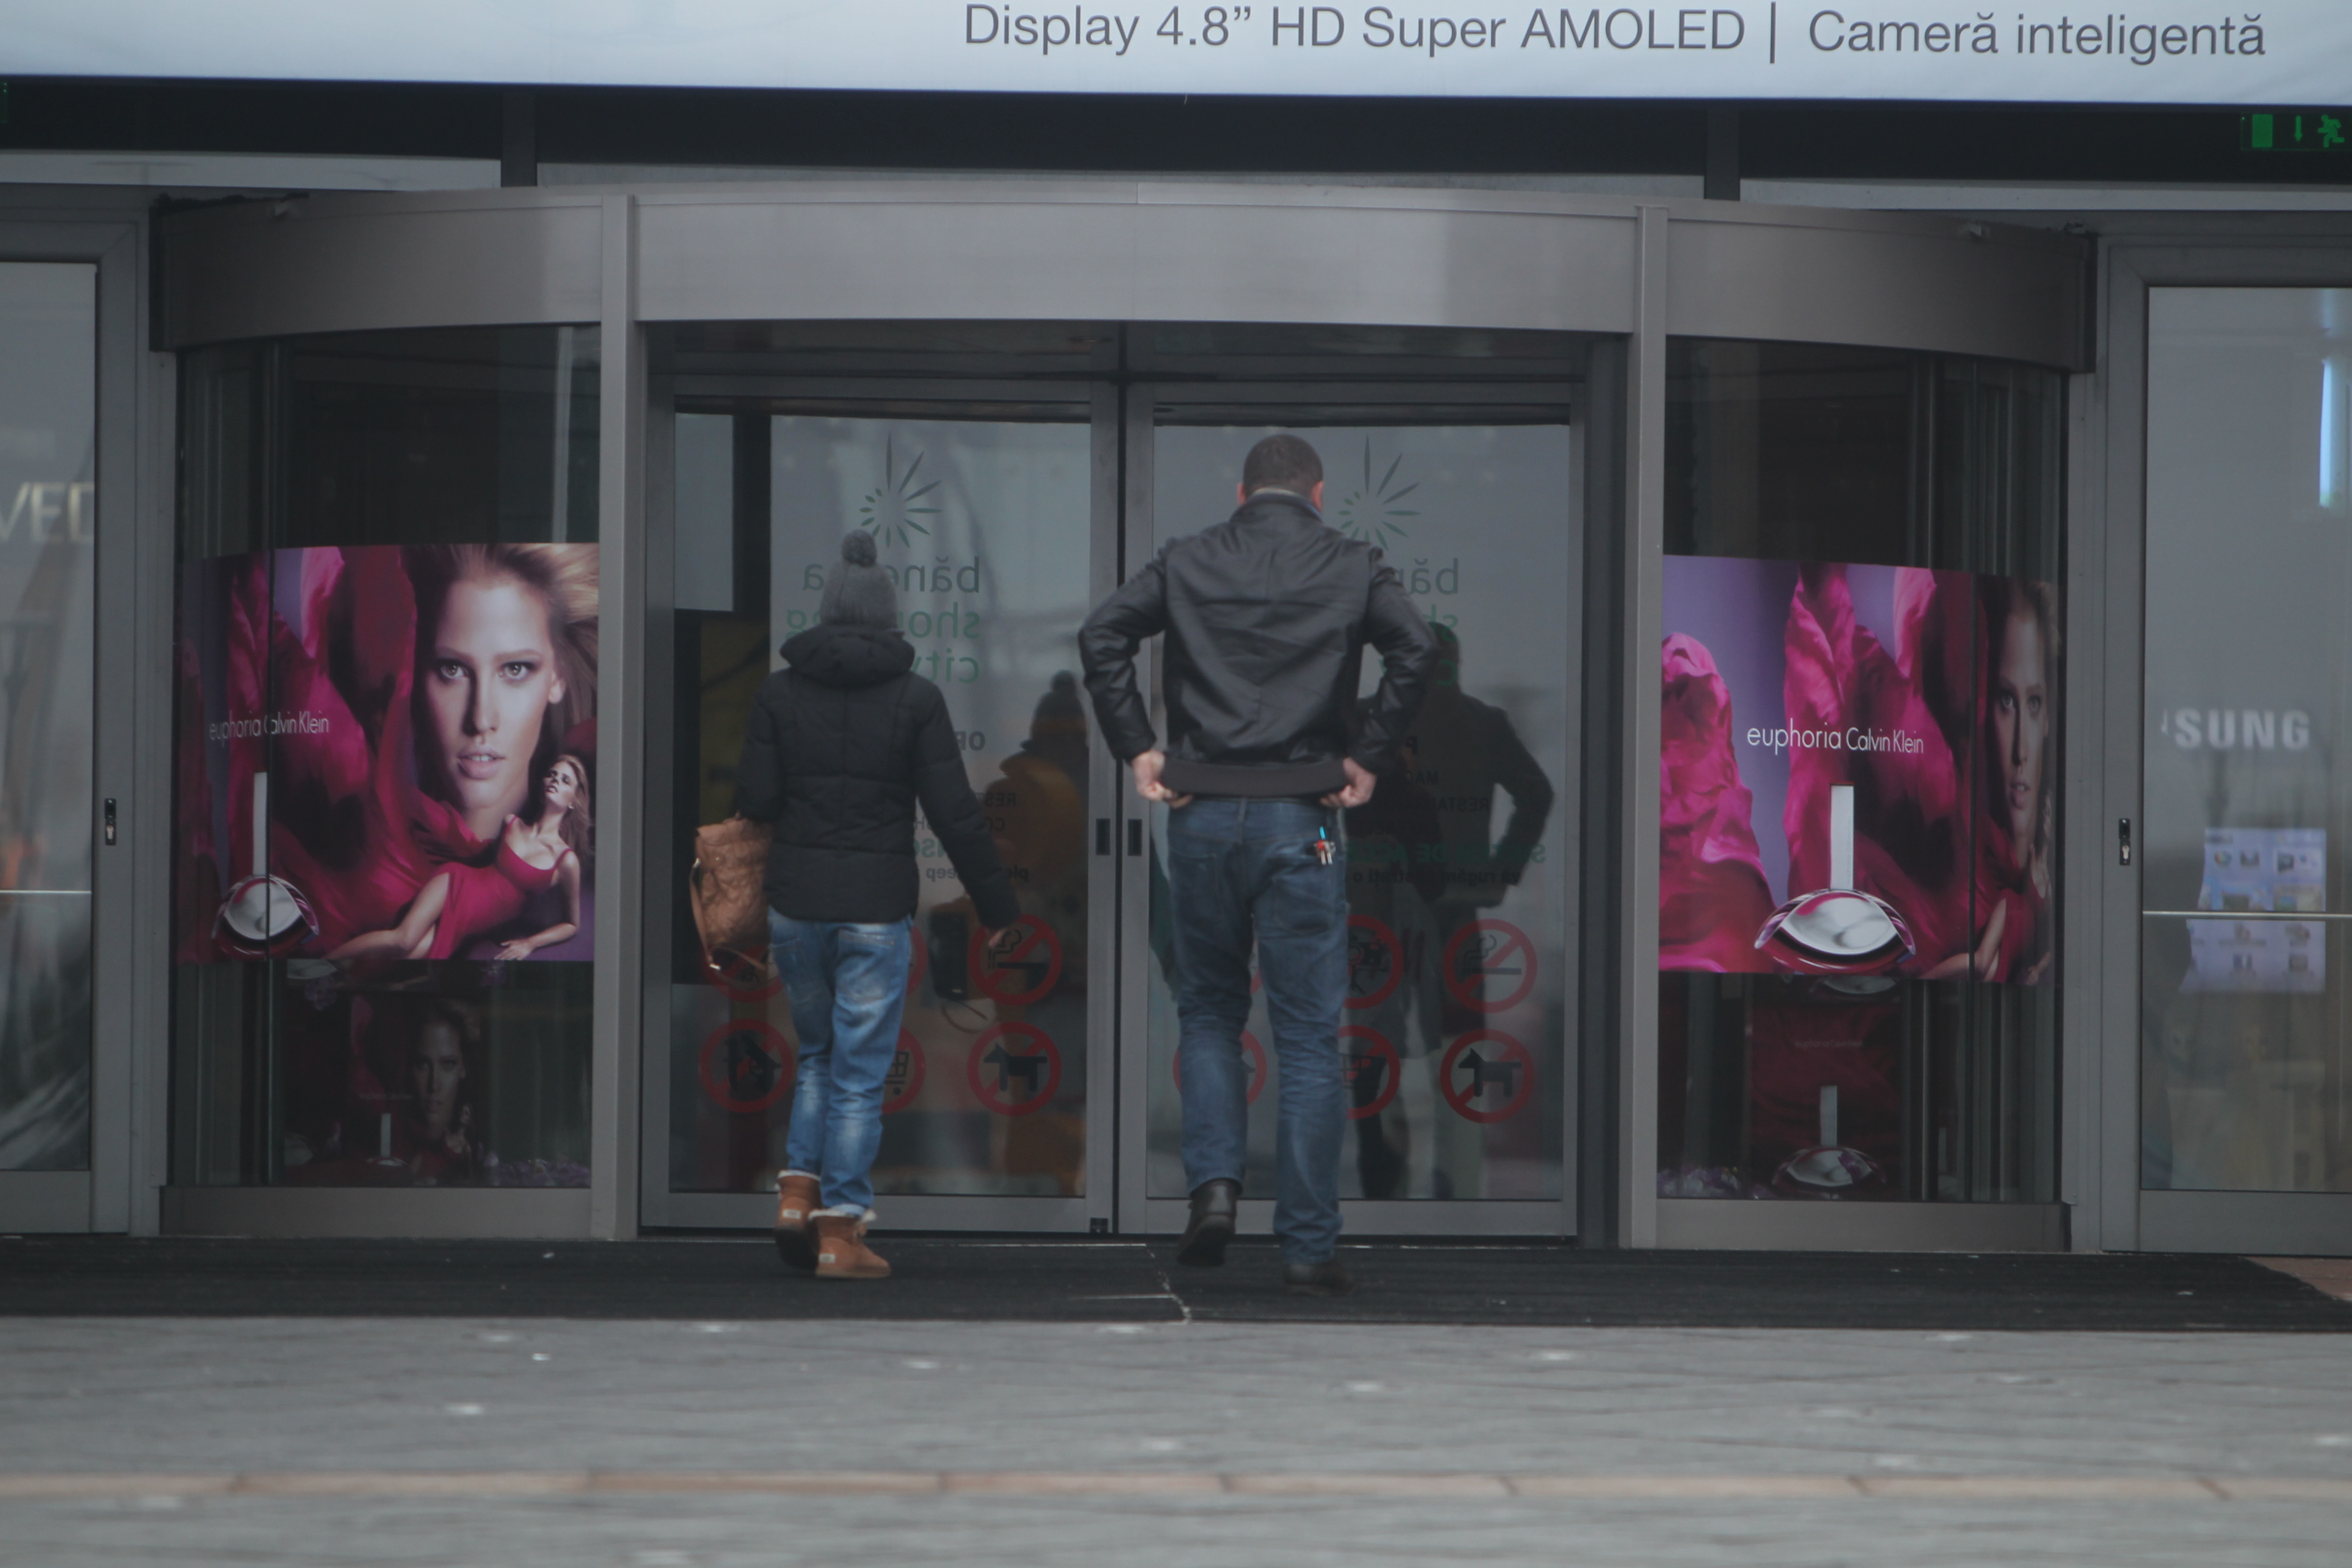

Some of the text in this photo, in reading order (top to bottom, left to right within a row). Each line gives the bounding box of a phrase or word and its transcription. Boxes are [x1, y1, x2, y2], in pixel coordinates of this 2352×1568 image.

[965, 3, 1140, 56] Display
[1271, 5, 1345, 47] HD
[1362, 6, 1507, 58] Super
[1519, 7, 1745, 50] AMOLED
[1808, 9, 1999, 54] Cameră
[2016, 13, 2266, 66] inteligentă
[210, 710, 261, 747] euphoria
[299, 710, 329, 734] Klein
[1747, 717, 1924, 756] euphoria Calvin Klein
[2161, 708, 2310, 750] SUNG
